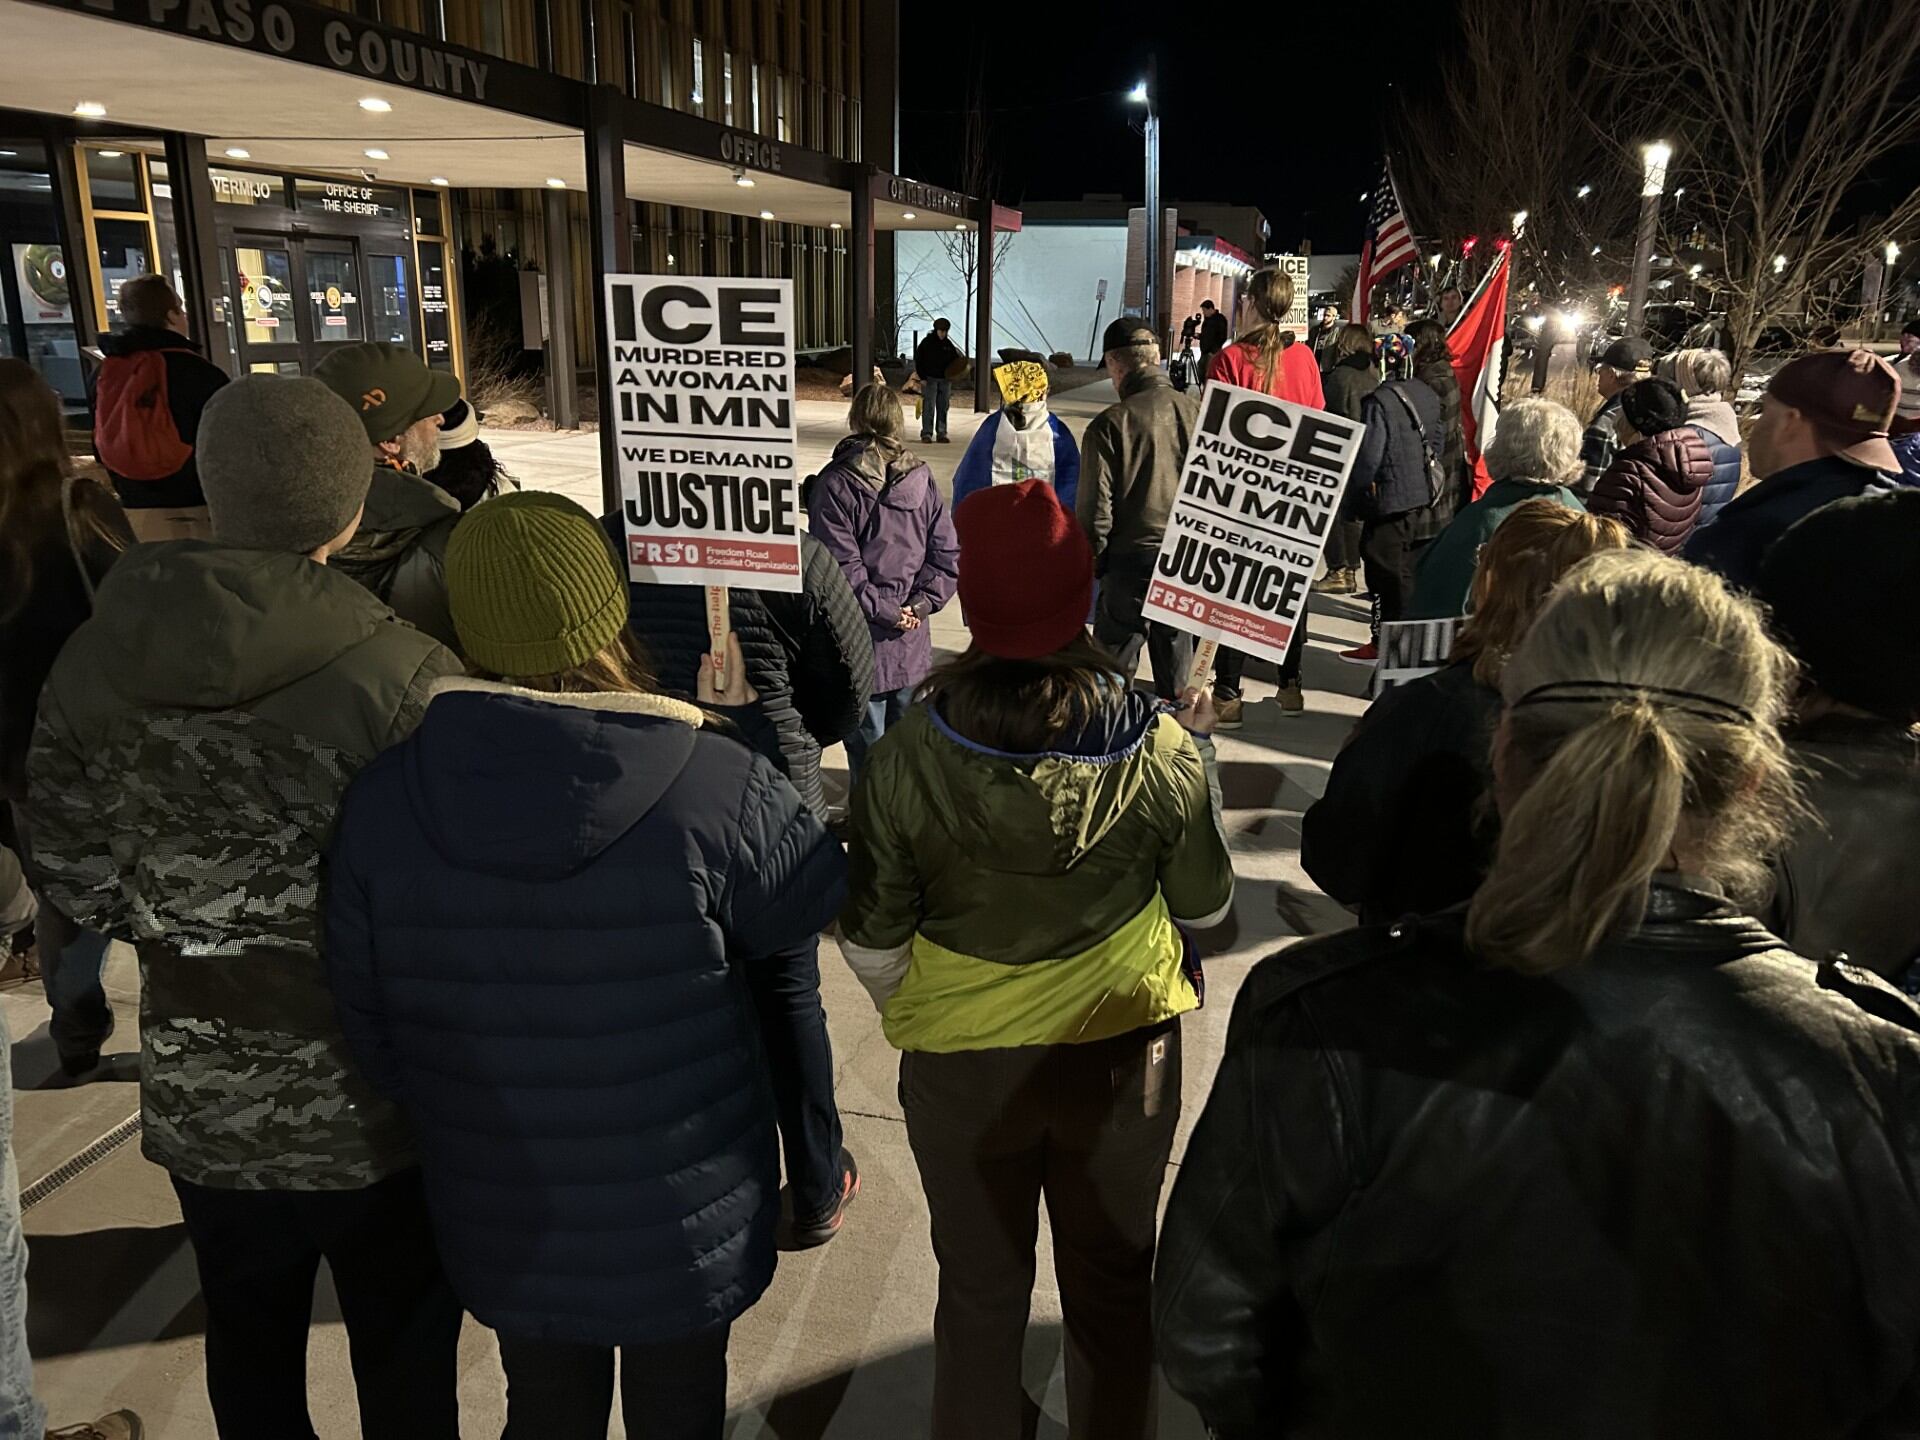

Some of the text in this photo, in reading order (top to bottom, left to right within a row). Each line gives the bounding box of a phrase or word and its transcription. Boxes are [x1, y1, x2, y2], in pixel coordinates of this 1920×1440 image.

[324, 20, 489, 99] COUNTY
[720, 132, 781, 171] OFFICE
[211, 176, 270, 199] VERMIJO
[326, 183, 373, 200] OFFICE OF
[322, 198, 379, 216] THE SHERIFF
[1280, 259, 1306, 274] ICE
[611, 284, 785, 346] ICE
[615, 346, 786, 368] MURDERED
[616, 368, 787, 392] A WOMAN
[620, 391, 790, 428] IN MN
[1202, 387, 1354, 474] ICE
[622, 447, 793, 469] WE DEMAND
[1195, 435, 1339, 489] MURDERED
[1190, 454, 1334, 509] A WOMAN
[625, 471, 796, 536] JUSTICE
[1184, 470, 1330, 537] IN MN
[1175, 512, 1314, 568] WE DEMAND
[706, 546, 769, 559] Freedom Road
[706, 556, 799, 571] Socialist Organization
[1158, 534, 1308, 620] JUSTICE
[712, 615, 721, 639] The
[1211, 608, 1266, 631] Freedom Road
[1194, 660, 1207, 677] The
